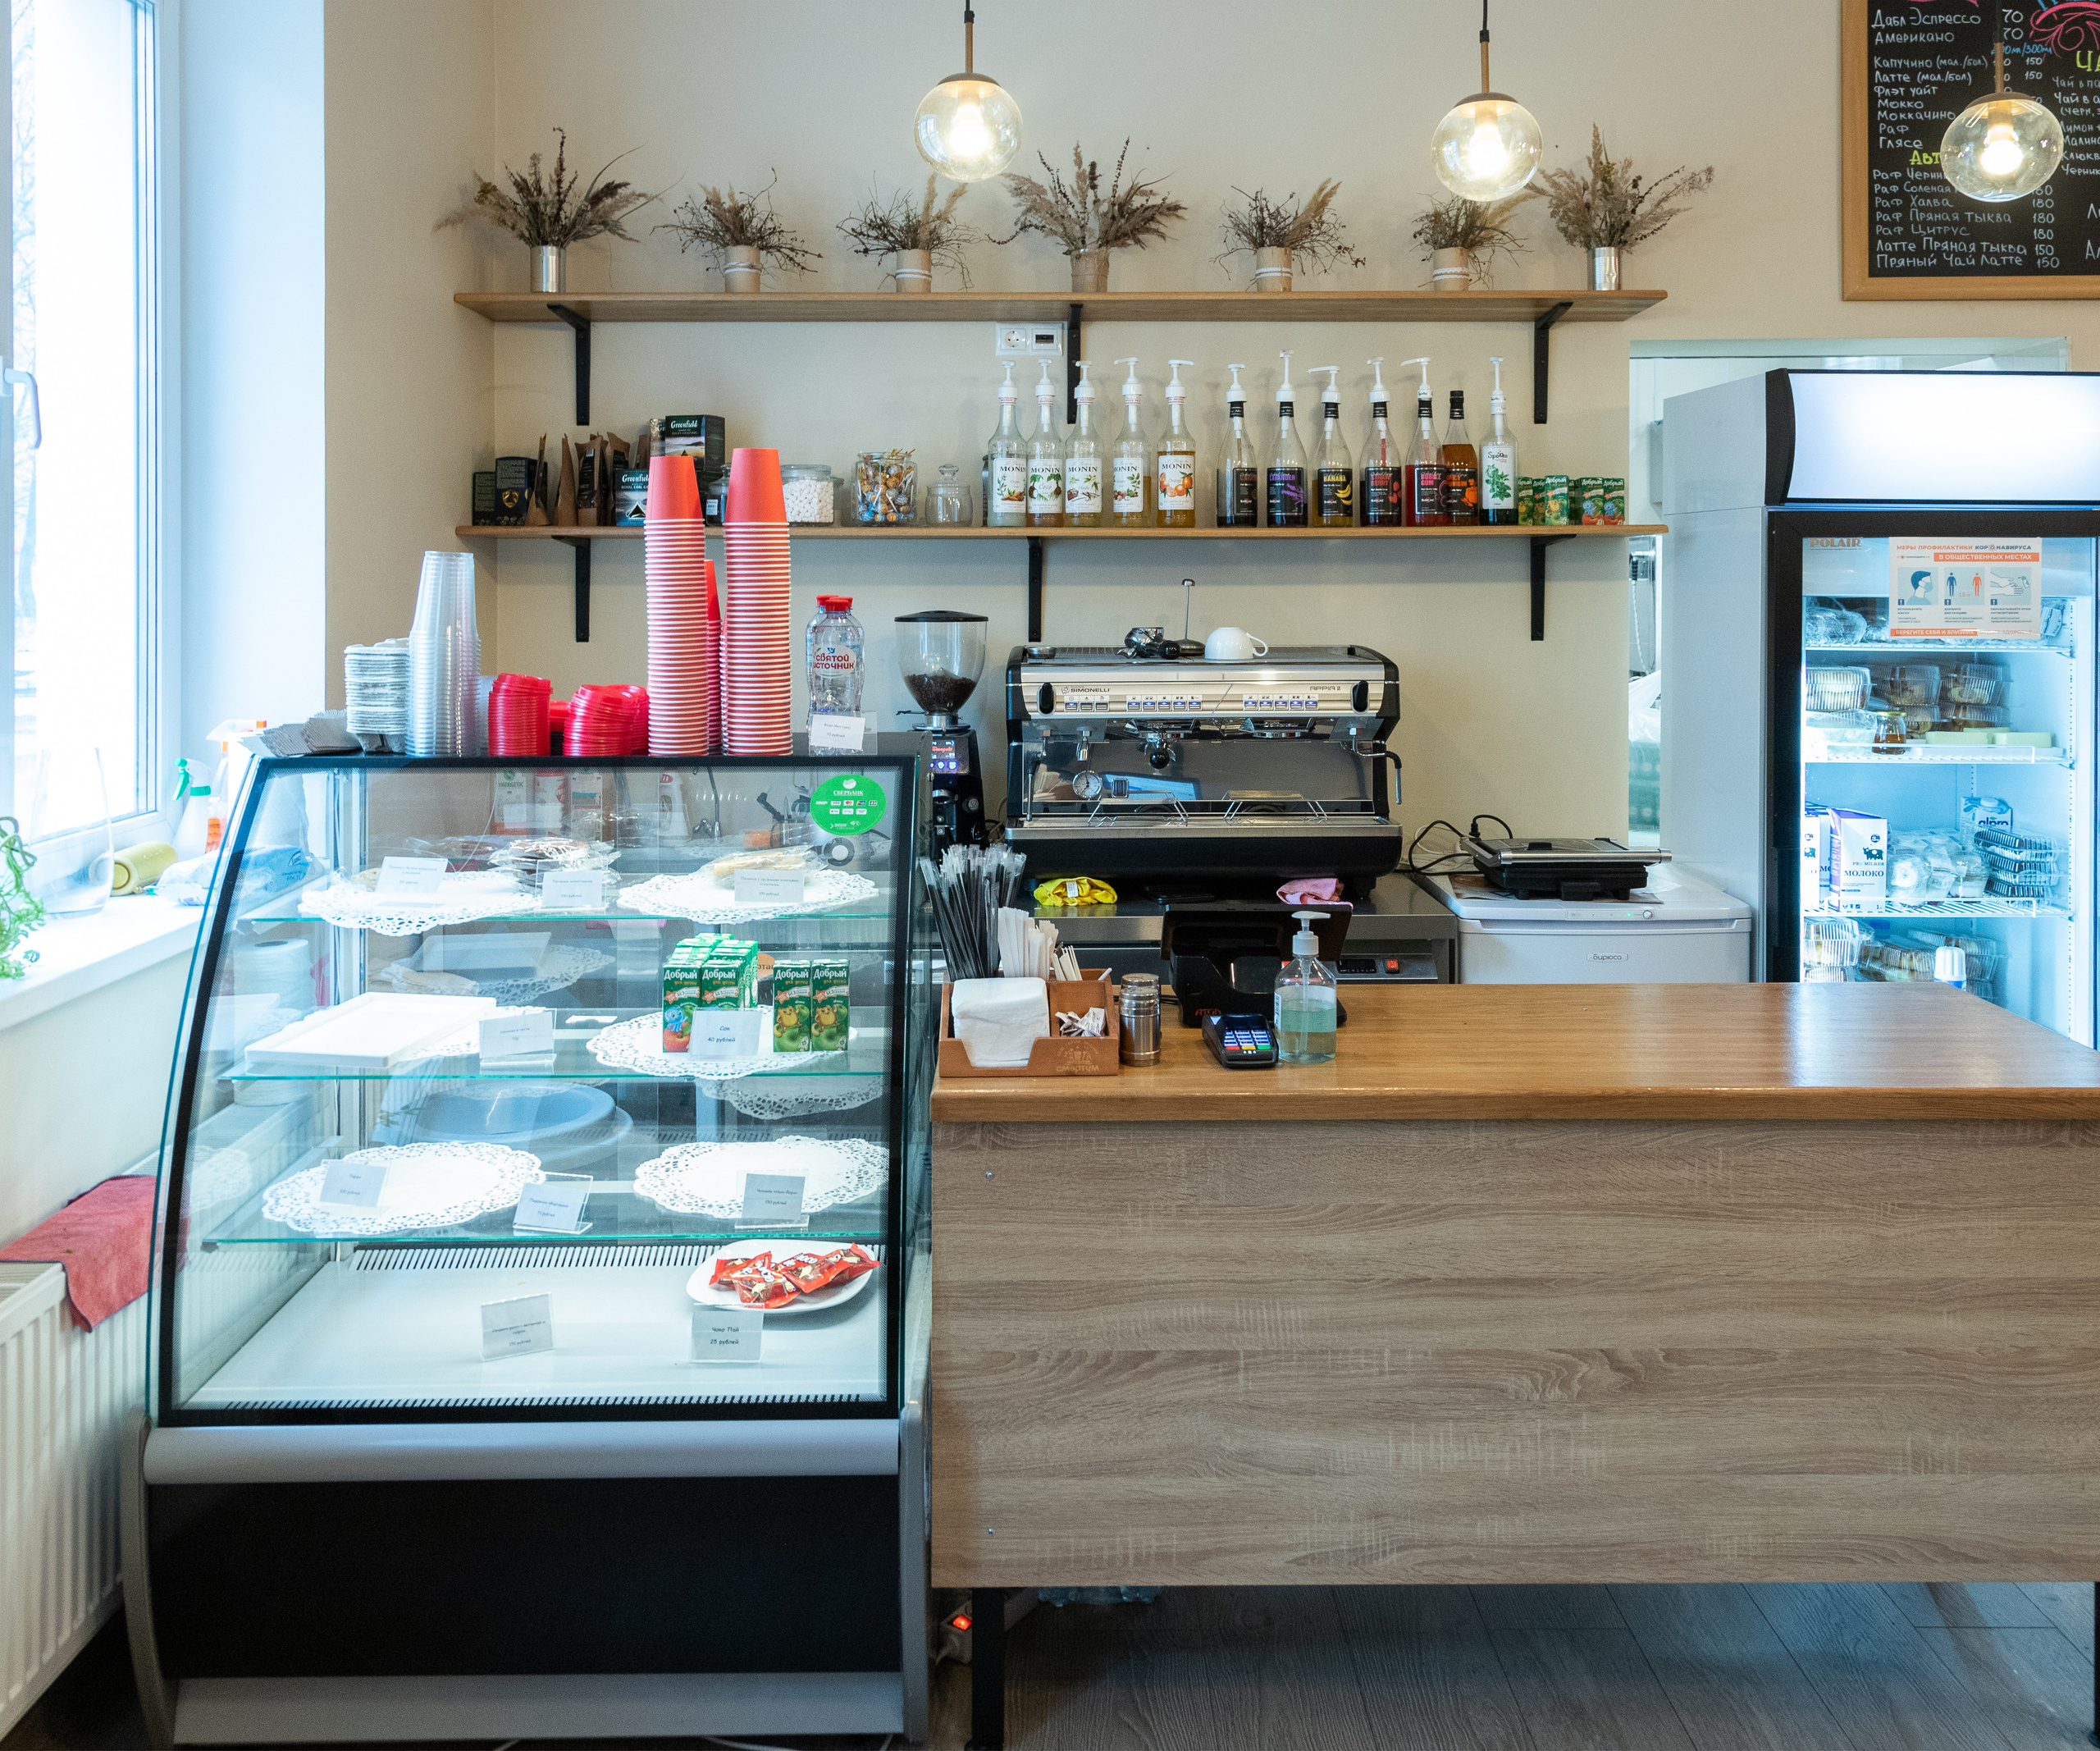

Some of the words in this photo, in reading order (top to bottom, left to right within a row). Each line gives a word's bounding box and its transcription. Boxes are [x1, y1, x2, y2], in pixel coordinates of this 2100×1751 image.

[1871, 9, 1906, 29] Дабл
[2002, 8, 2024, 23] 70
[1875, 31, 1955, 45] Американо
[2003, 27, 2024, 40] 70
[1874, 56, 1933, 69] Капучино
[2025, 57, 2043, 66] 150
[1875, 71, 1911, 83] Латте
[2025, 71, 2043, 80] 150
[2052, 75, 2074, 89] Чай
[1874, 85, 1905, 98] Флэт
[2054, 91, 2079, 104] Чай
[1878, 98, 1924, 109] Мокко
[1878, 110, 1956, 121] Моккачино
[1879, 123, 1909, 135] Раф
[1879, 136, 1924, 149] Глясе
[1873, 169, 1901, 180] Раф
[1874, 183, 1899, 194] Раф
[1903, 181, 1951, 194] Соленая
[1875, 197, 1902, 208] Раф
[1910, 194, 1954, 208] Халва
[2033, 199, 2054, 208] 180
[1876, 211, 1902, 222] Раф
[1910, 208, 1959, 222] Пряная
[2033, 213, 2054, 223] 180
[1876, 225, 1903, 235] Раф
[1911, 224, 1970, 236] Цитрус
[2033, 229, 2054, 240] 180
[1876, 240, 1916, 252] Латте
[1923, 237, 1976, 252] Пряная
[2035, 244, 2054, 256] 150
[1877, 253, 1937, 268] Пряный
[1943, 253, 1975, 267] Чай
[1980, 254, 2022, 266] Латте
[2037, 257, 2060, 268] 150
[670, 420, 698, 429] Greenfield
[1810, 537, 1860, 547] POLAIR
[664, 969, 697, 981] Добрый
[702, 969, 736, 981] Добрый
[774, 969, 809, 981] Добрый
[813, 968, 847, 980] Добрый
